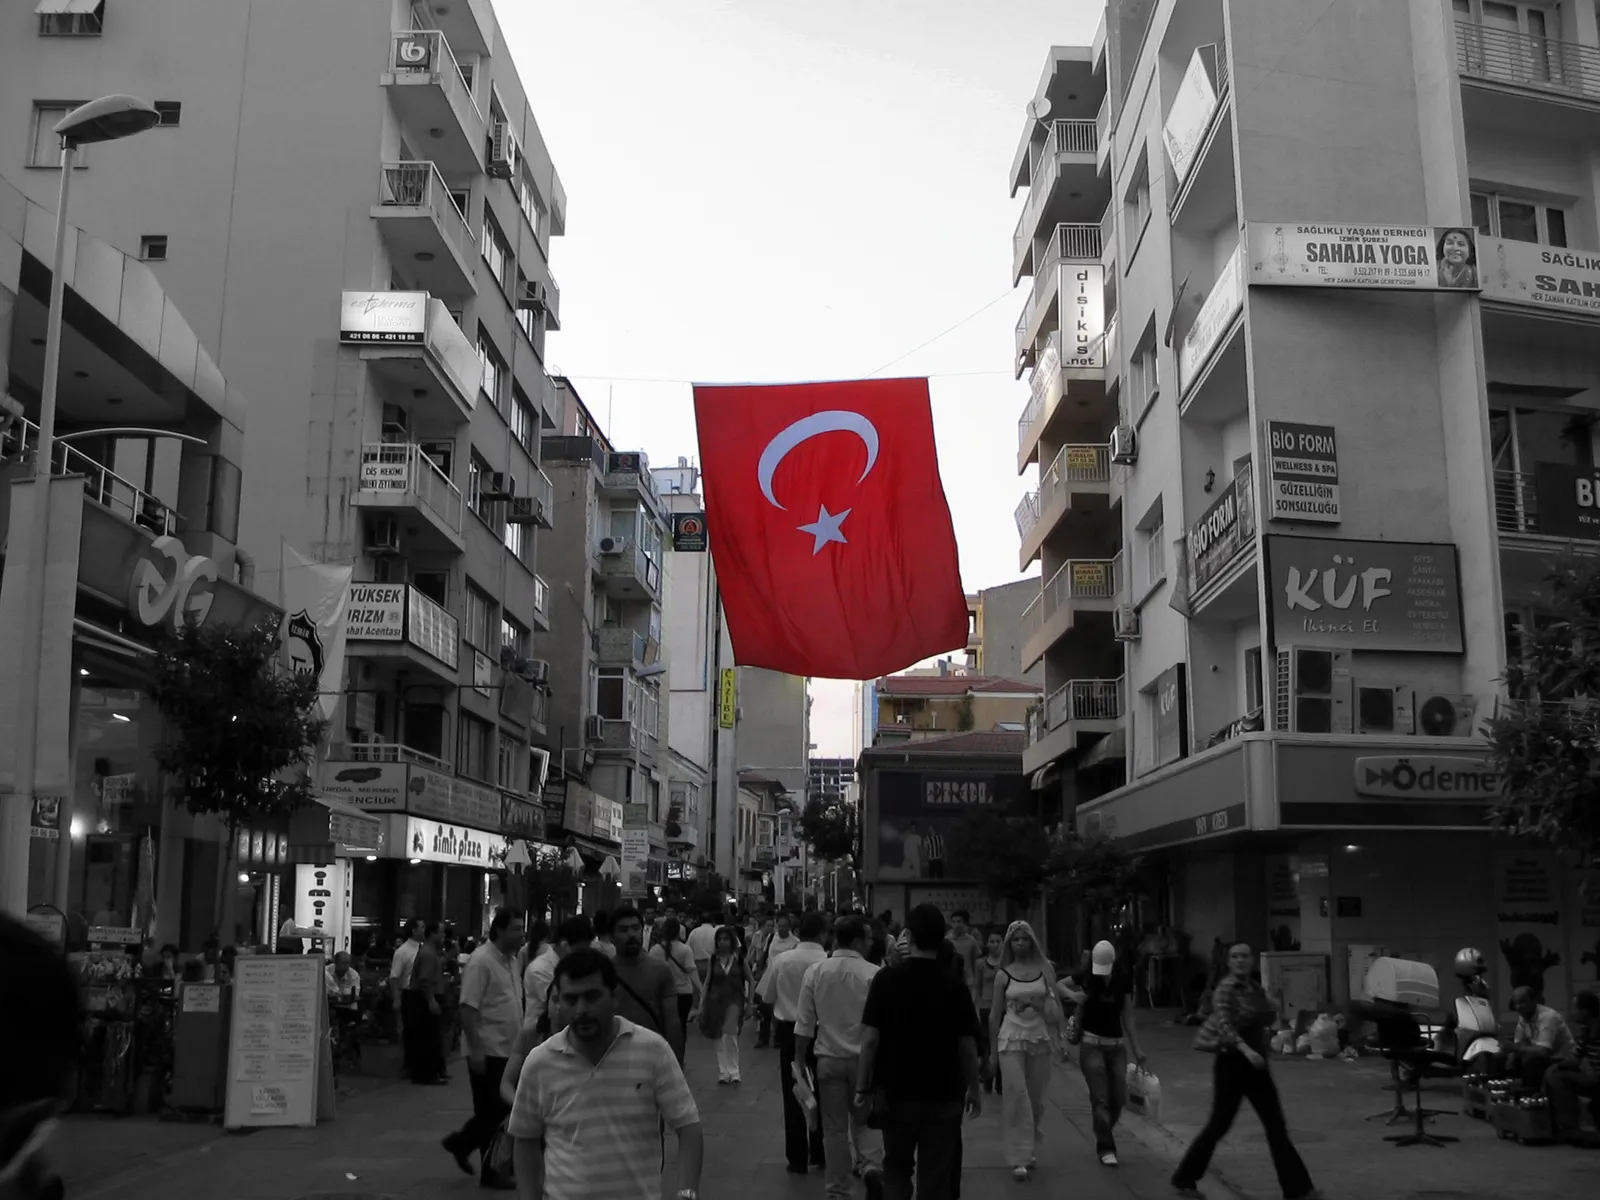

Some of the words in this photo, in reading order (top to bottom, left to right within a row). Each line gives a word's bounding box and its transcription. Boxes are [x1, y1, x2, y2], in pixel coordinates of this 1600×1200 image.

[1297, 226, 1343, 235] SAĞLIKLI
[1346, 227, 1381, 238] YAŞAM
[1383, 228, 1427, 237] DERNEĞİ
[1306, 242, 1376, 264] SAHAJA
[1377, 244, 1429, 266] YOGA
[1066, 357, 1095, 366] .net
[1272, 429, 1295, 451] BİO
[1298, 433, 1335, 454] FORM
[365, 465, 377, 476] DİŞ
[1275, 461, 1313, 472] WELLNESS
[1314, 464, 1320, 473] &
[1321, 464, 1336, 474] SPA
[1276, 499, 1338, 515] SONSUZLUĞU
[1208, 495, 1234, 544] FORM
[1284, 554, 1392, 613] KÜF
[350, 585, 402, 603] YÜKSEK
[365, 626, 401, 637] Acentası
[1362, 619, 1380, 634] El
[433, 824, 457, 856] simit
[458, 829, 482, 861] pizza
